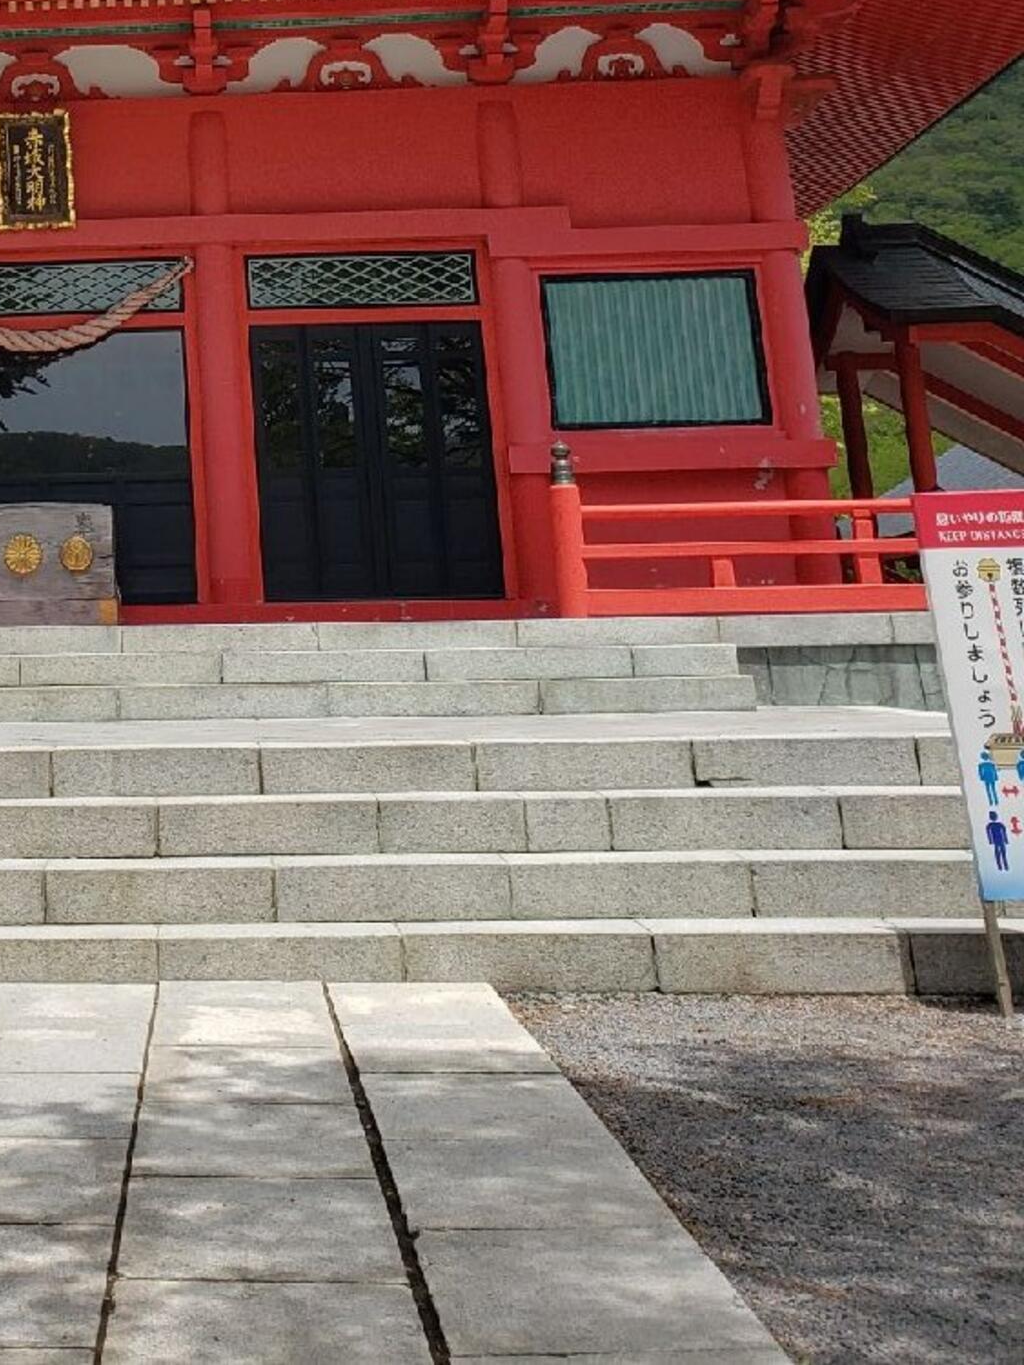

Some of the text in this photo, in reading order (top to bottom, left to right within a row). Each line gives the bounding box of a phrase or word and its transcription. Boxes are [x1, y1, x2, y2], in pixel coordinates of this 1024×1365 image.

[938, 530, 967, 543] KEEP
[952, 559, 996, 728] お参りしましょう
